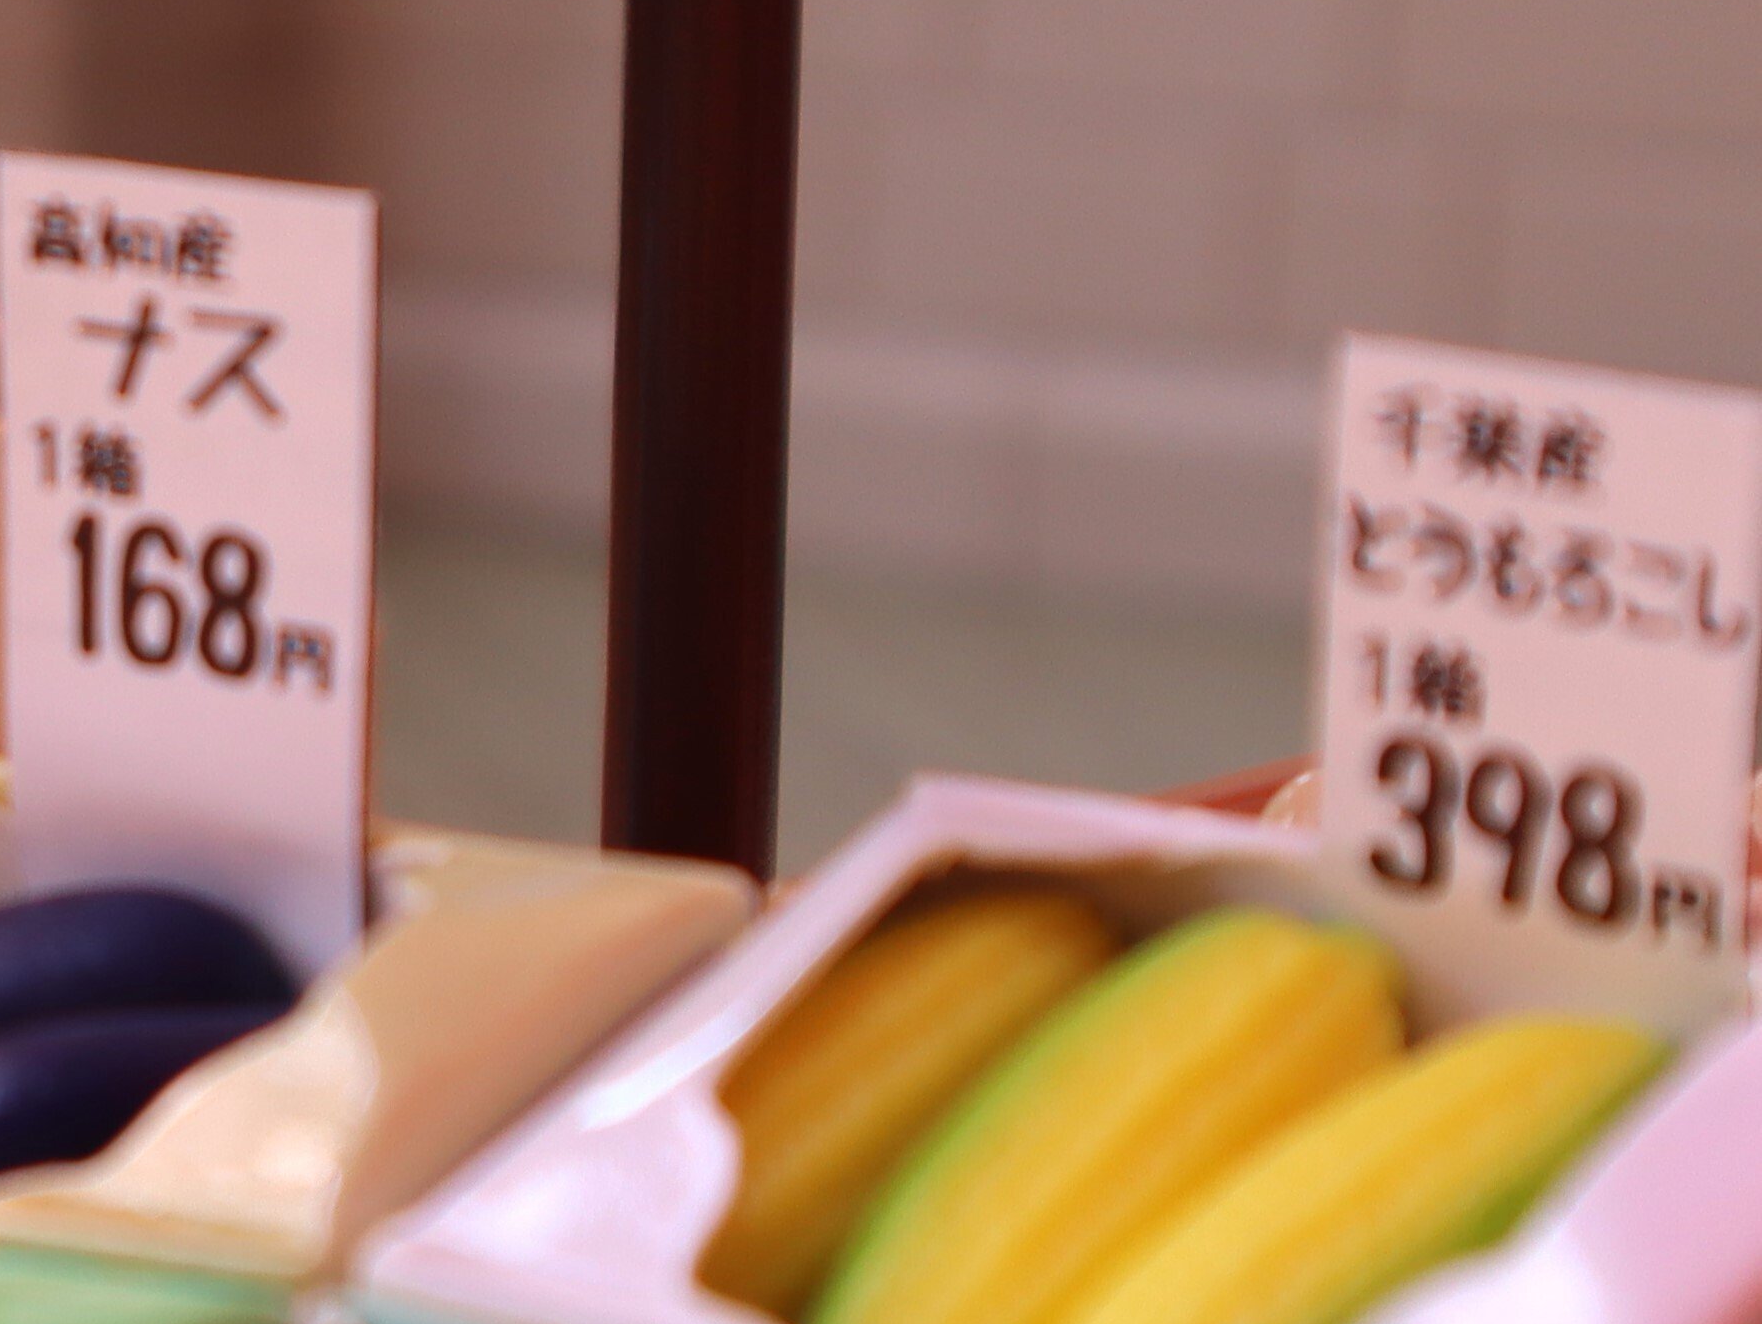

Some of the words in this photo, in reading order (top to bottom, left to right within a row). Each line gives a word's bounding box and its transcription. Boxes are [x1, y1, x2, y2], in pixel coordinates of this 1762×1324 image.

[78, 297, 285, 423] ナス
[1347, 492, 1747, 650] とうもろこし
